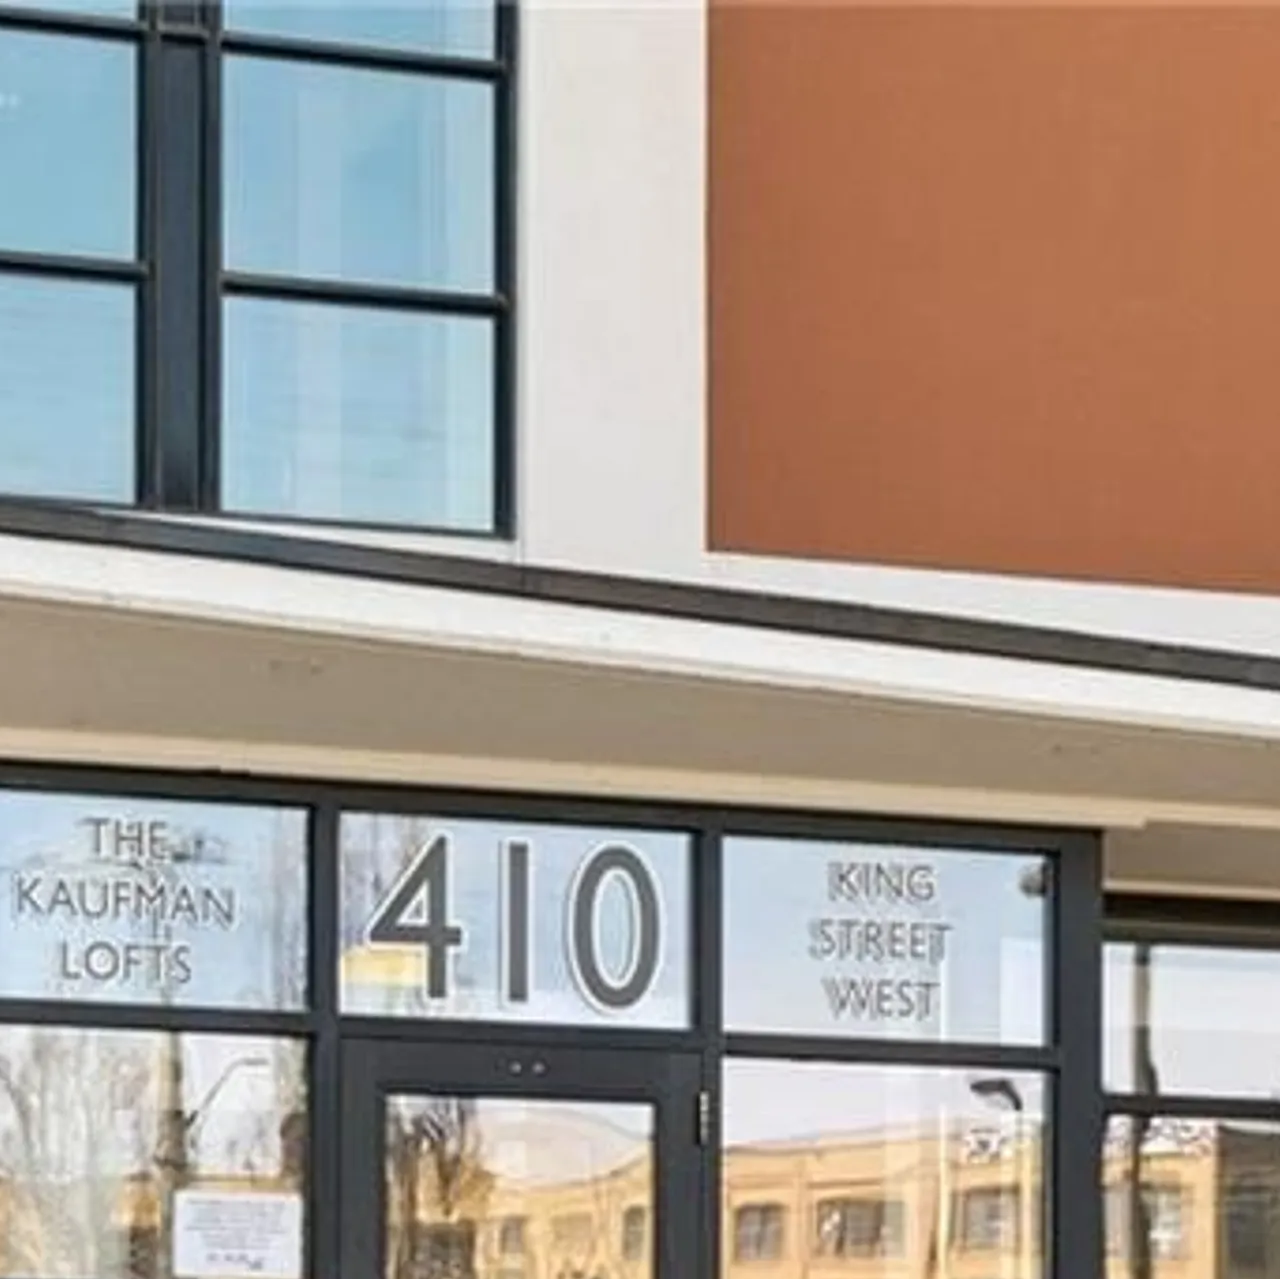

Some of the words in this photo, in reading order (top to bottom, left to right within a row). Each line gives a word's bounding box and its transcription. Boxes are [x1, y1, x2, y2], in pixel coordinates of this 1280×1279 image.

[82, 817, 167, 861] THE
[15, 874, 236, 925] KAUFMAN
[827, 862, 935, 901] KING
[367, 833, 662, 1009] 410
[809, 918, 954, 965] STREET
[60, 941, 193, 984] LOFTS
[822, 978, 941, 1021] WEST
